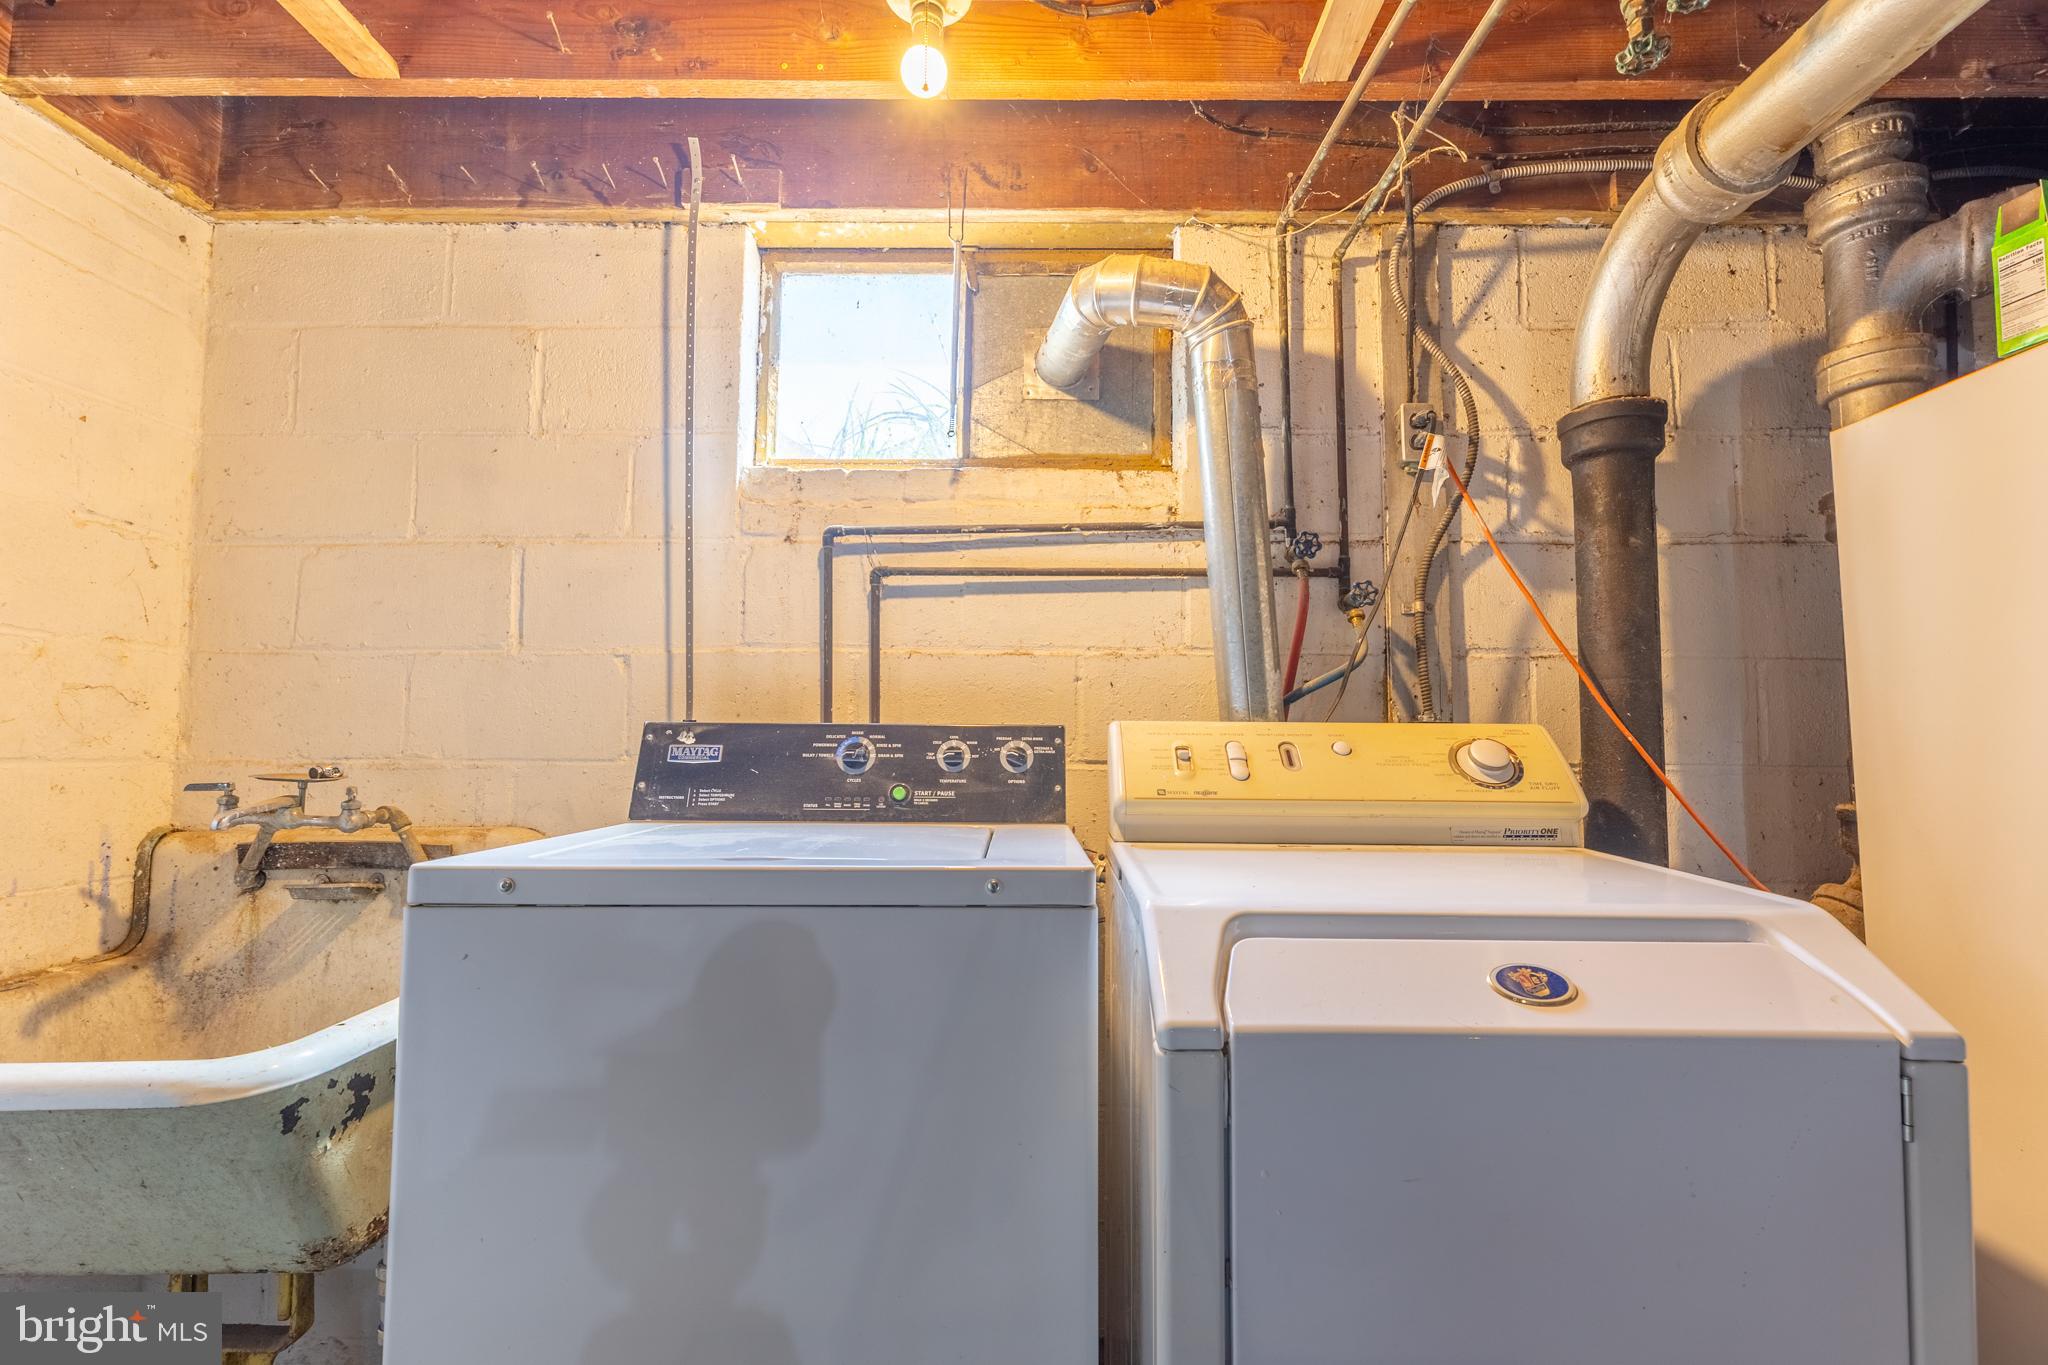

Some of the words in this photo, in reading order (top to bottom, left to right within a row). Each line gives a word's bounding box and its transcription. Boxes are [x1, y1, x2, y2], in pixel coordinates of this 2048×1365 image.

[1998, 248, 2025, 263] Nutrition
[2026, 240, 2043, 251] Facts
[2032, 256, 2045, 265] 100
[671, 747, 719, 757] MAYTAG
